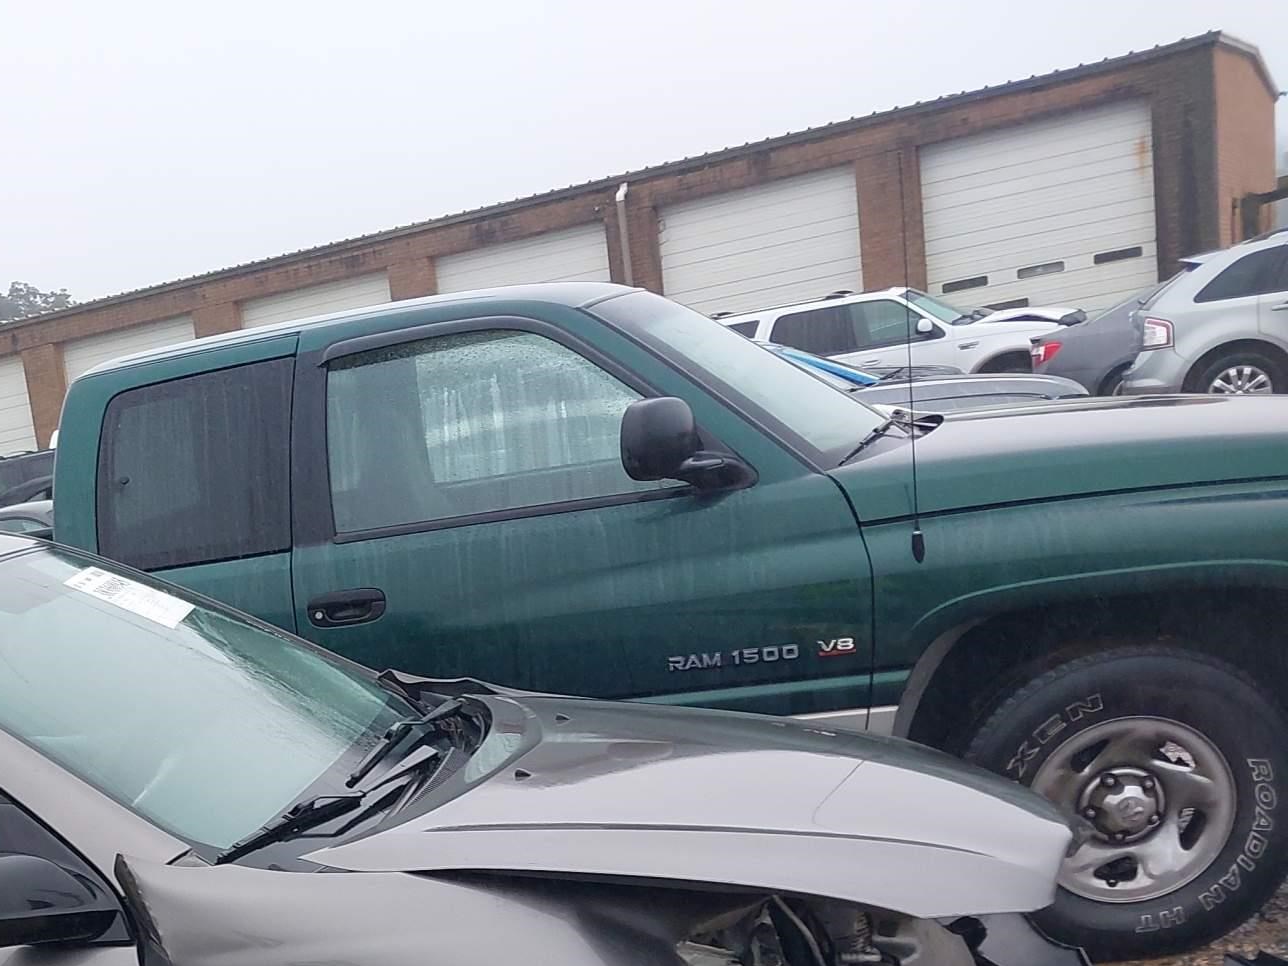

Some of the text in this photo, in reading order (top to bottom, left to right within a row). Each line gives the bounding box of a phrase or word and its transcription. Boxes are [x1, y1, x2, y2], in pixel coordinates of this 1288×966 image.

[668, 643, 800, 672] RAM 1500
[817, 637, 856, 655] V8
[1006, 692, 1104, 780] XEN
[1135, 758, 1278, 934] ROADIAN HT
